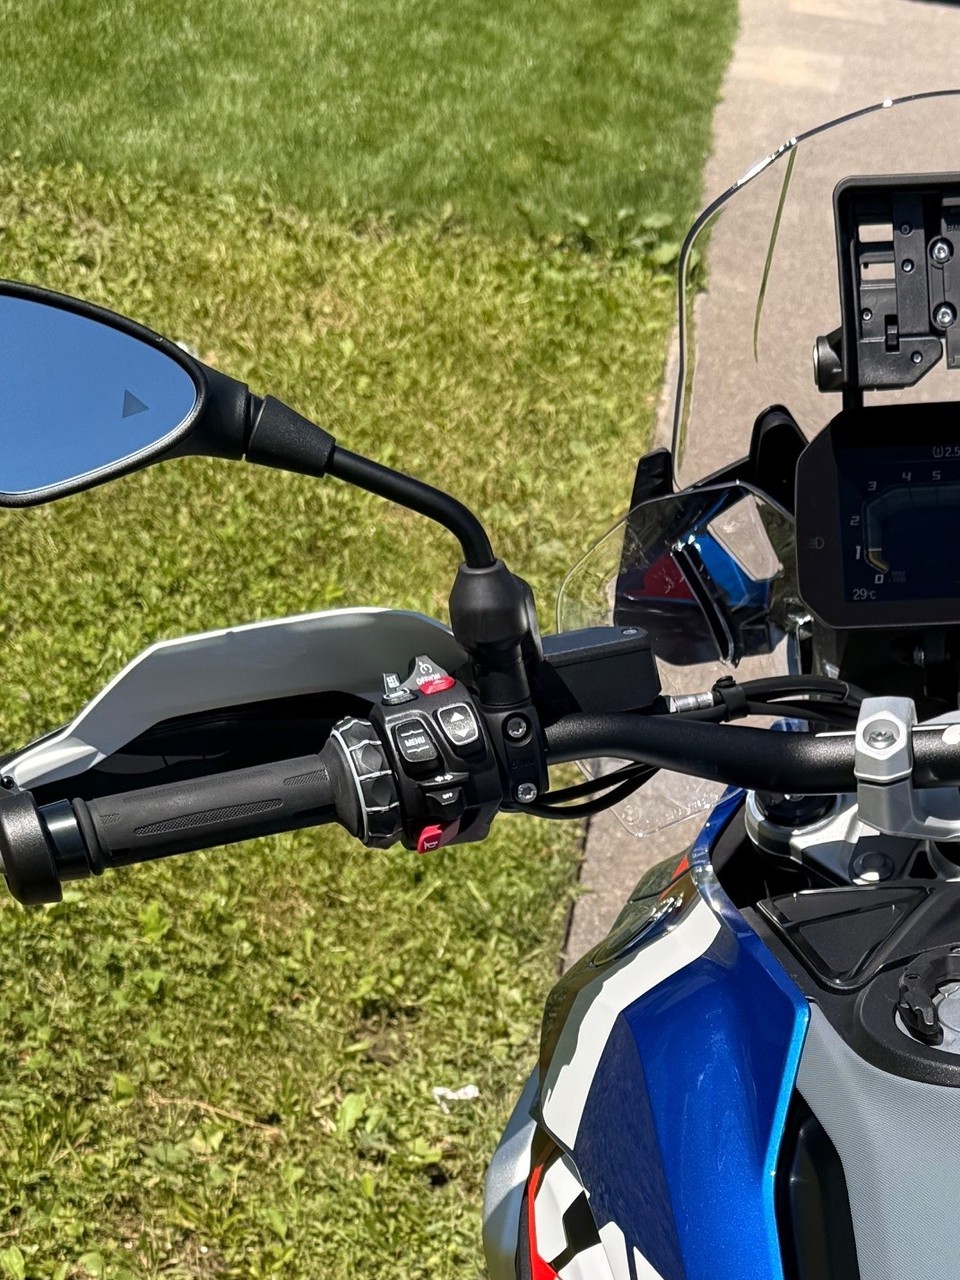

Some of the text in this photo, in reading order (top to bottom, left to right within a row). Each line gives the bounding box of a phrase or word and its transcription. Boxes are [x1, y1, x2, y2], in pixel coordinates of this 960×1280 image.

[868, 481, 877, 491] 3
[902, 471, 912, 481] 4
[932, 470, 942, 480] 5
[850, 516, 860, 526] 2
[855, 546, 861, 560] 1
[874, 574, 884, 584] 0
[404, 736, 426, 747] MENU
